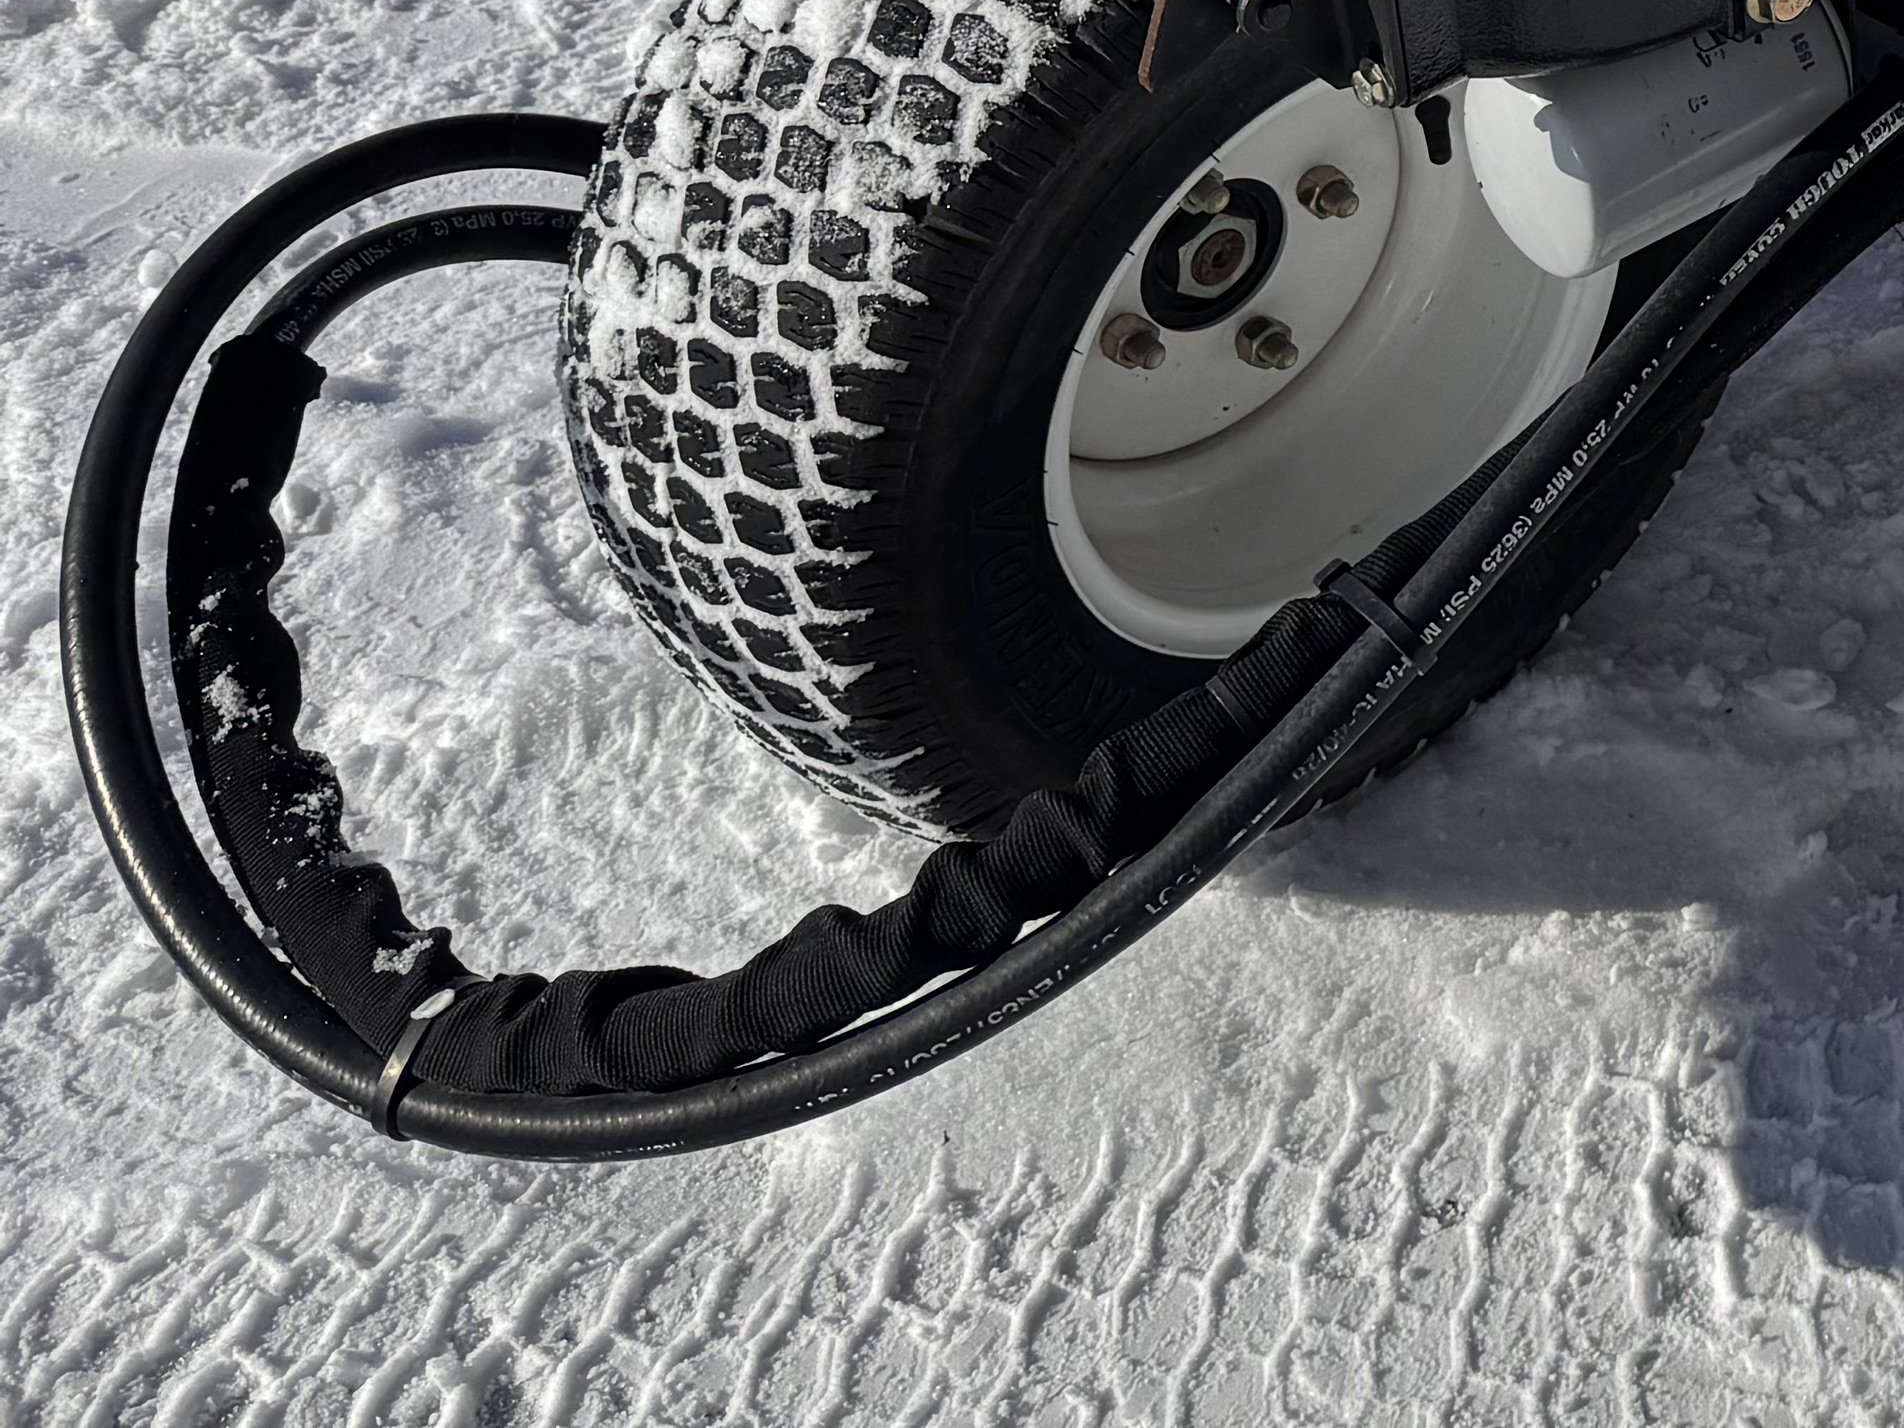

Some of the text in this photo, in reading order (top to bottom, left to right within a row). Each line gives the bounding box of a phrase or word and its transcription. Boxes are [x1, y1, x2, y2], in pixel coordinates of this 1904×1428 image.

[1786, 143, 1865, 221] TOUGH
[451, 211, 497, 229] MPa
[1529, 465, 1574, 514] MPa
[1481, 515, 1533, 573] (3625
[971, 474, 1134, 744] KENDA
